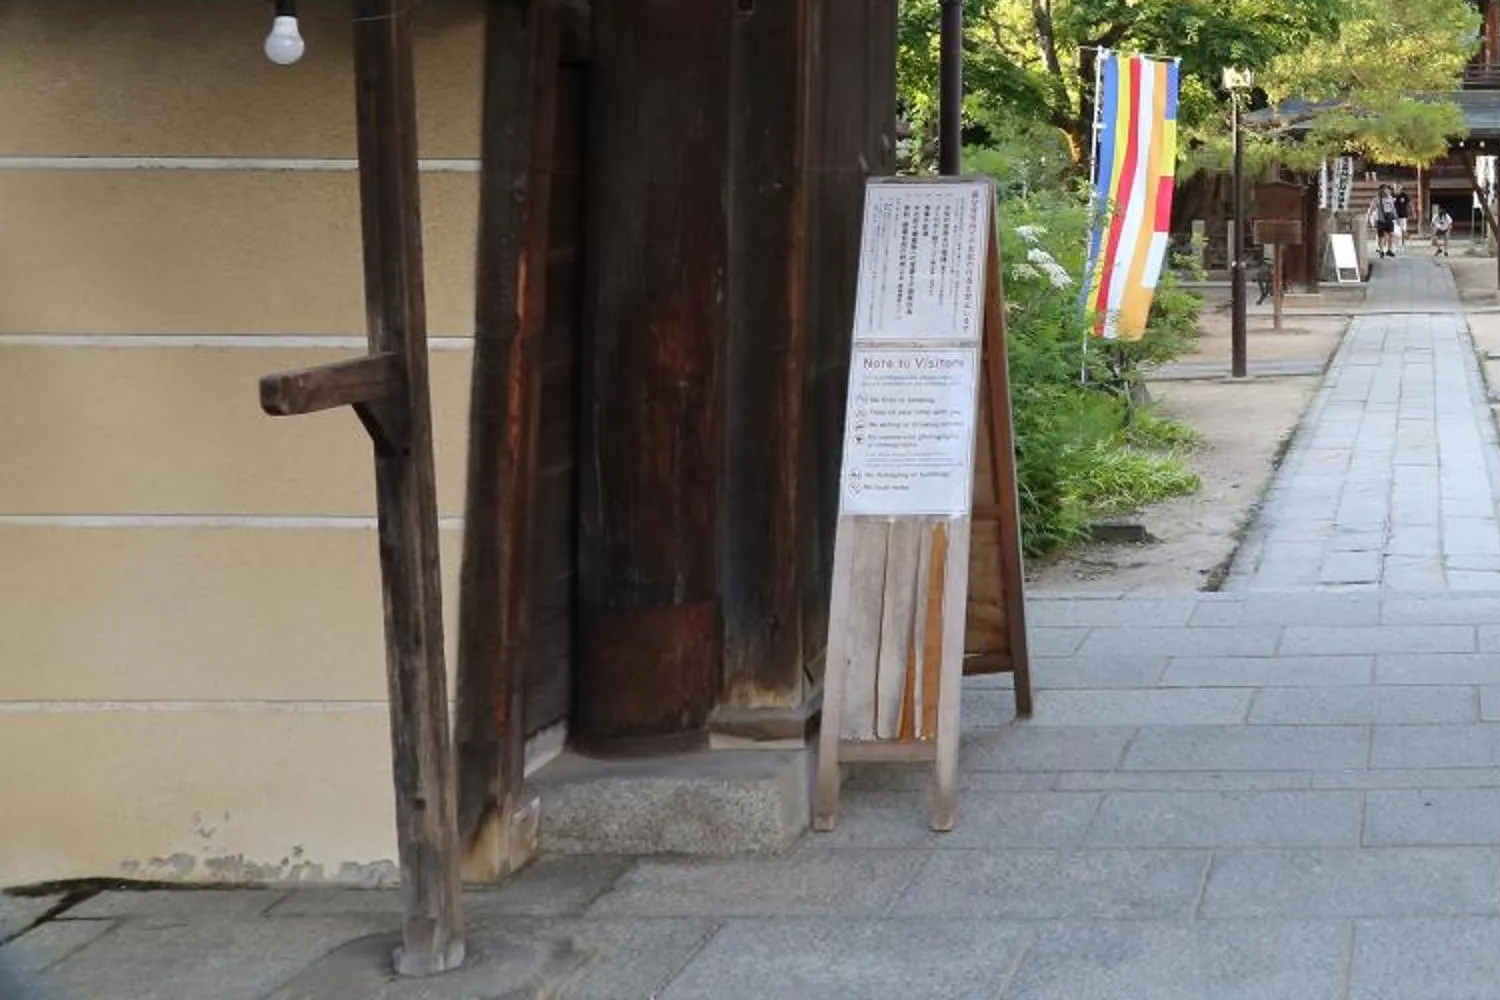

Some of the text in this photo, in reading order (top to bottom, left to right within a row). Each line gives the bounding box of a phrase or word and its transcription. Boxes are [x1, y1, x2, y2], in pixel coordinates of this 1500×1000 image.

[863, 357, 965, 369] Note to Visitors
